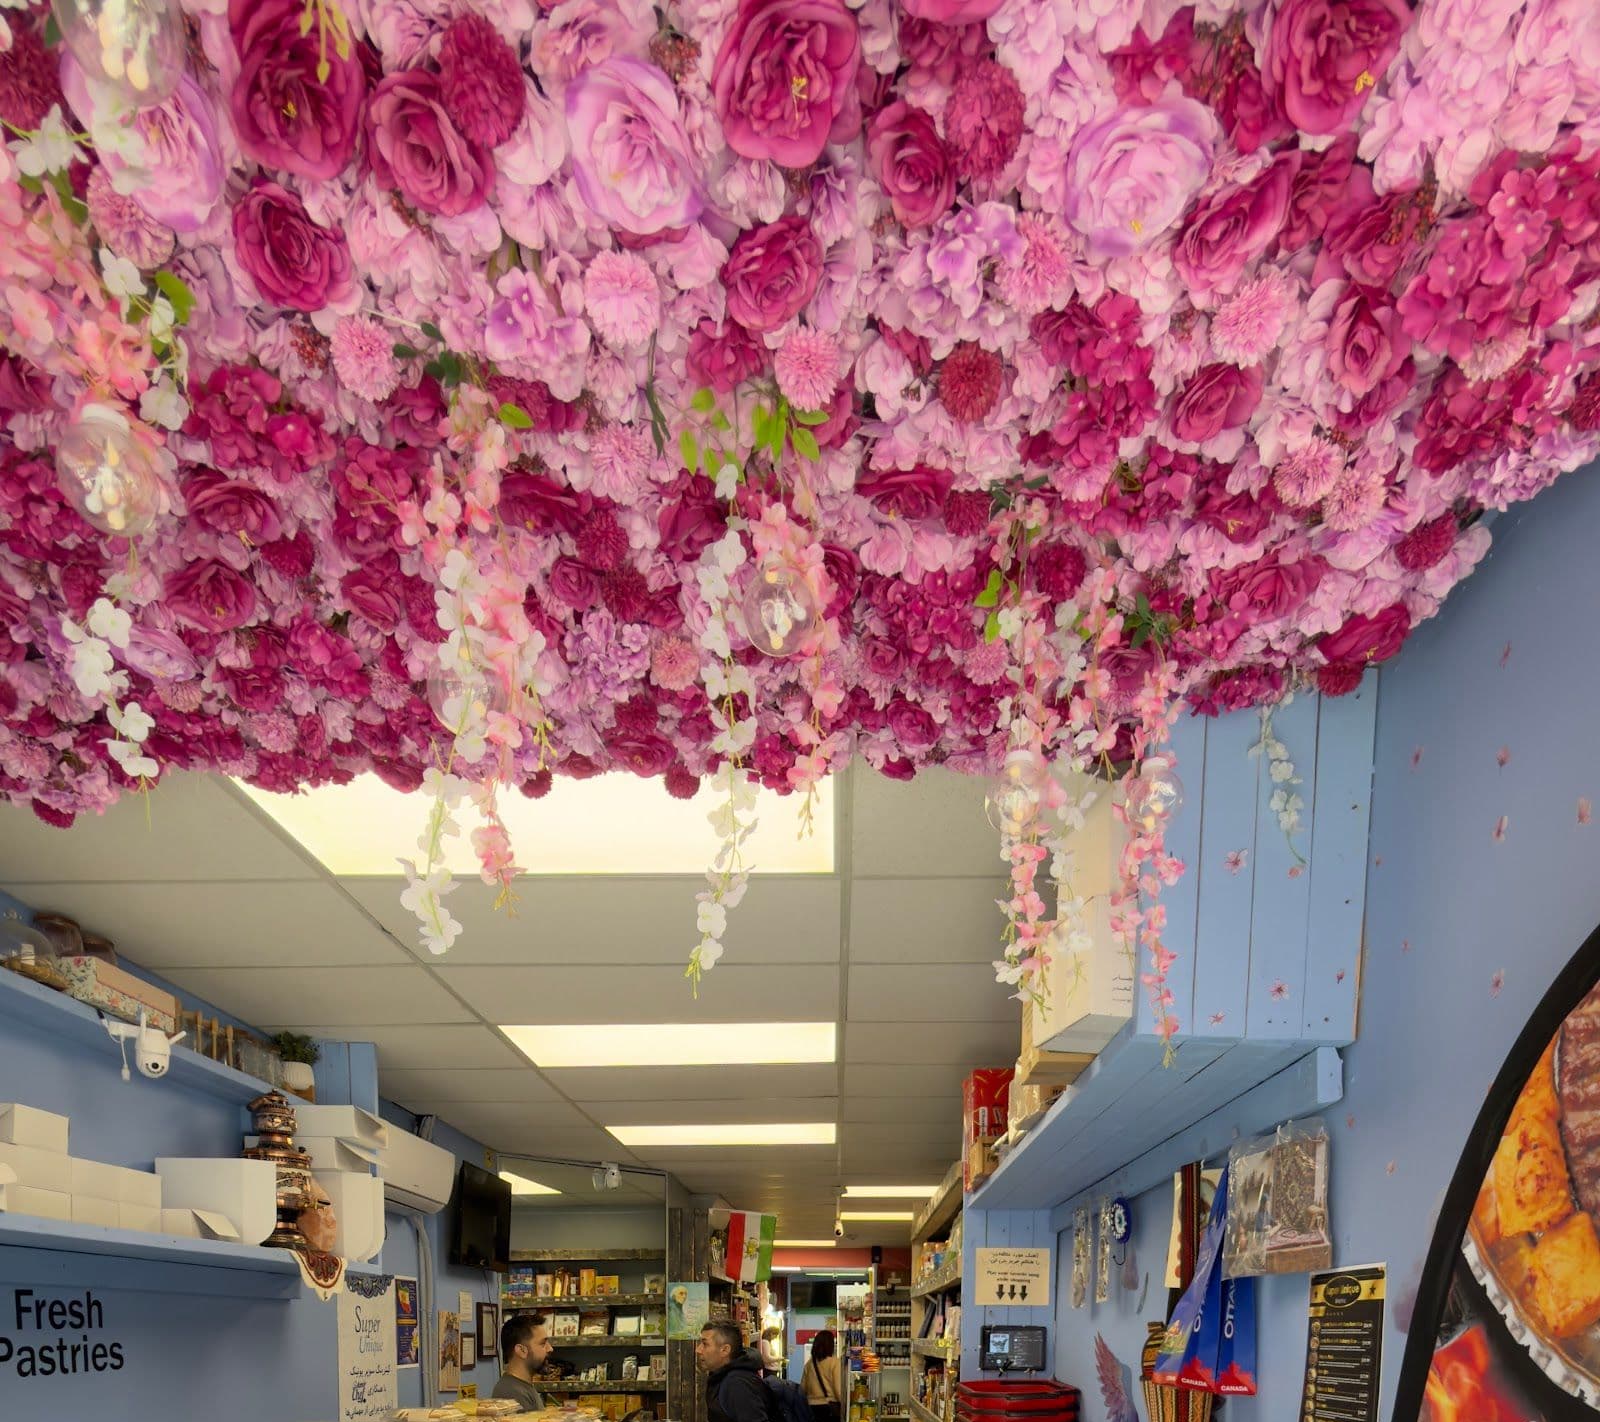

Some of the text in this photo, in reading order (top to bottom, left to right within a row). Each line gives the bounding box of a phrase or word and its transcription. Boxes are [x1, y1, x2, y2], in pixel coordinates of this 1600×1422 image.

[15, 1289, 104, 1330] Fresh
[355, 1305, 382, 1338] Super
[0, 1334, 125, 1378] Pastries
[1181, 1377, 1208, 1387] CANADA
